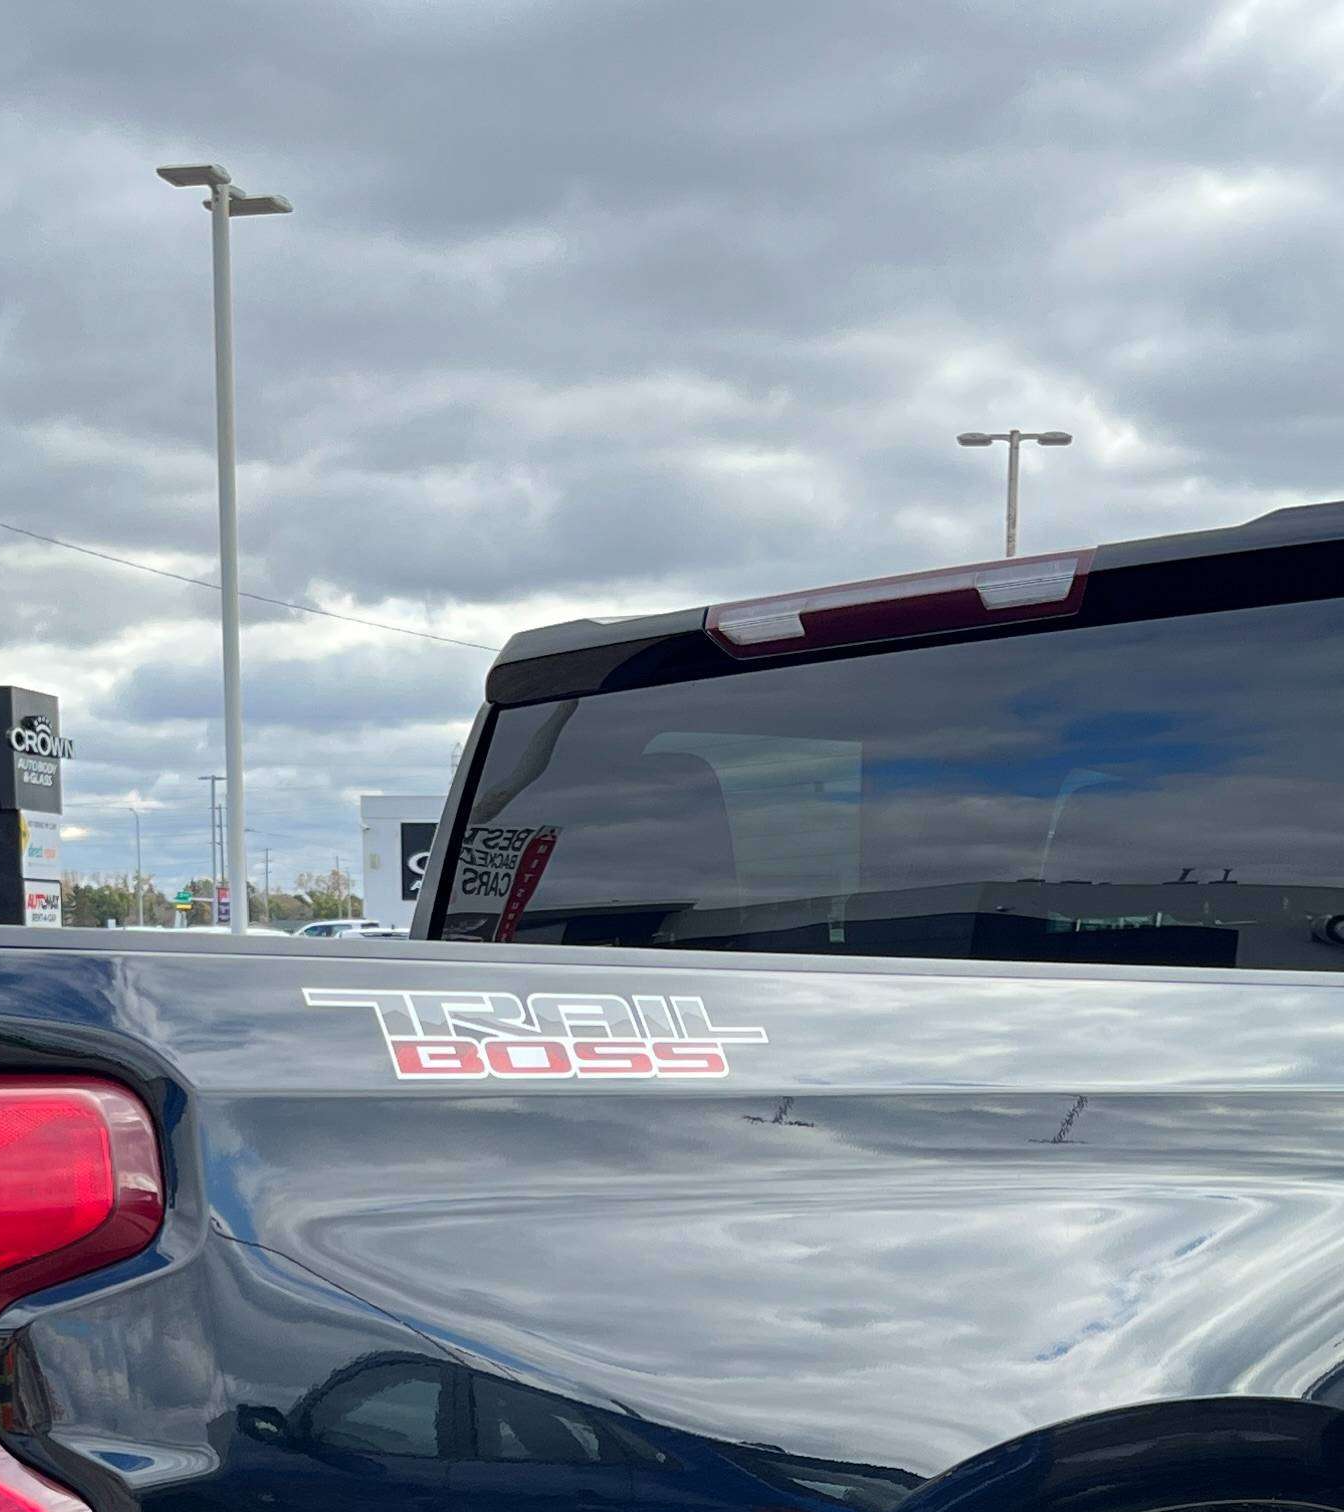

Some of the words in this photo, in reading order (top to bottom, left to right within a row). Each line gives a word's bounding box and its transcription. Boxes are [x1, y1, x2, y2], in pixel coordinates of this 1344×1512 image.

[10, 727, 76, 760] CROWN
[301, 987, 769, 1043] TRAIL
[390, 1039, 730, 1080] BOSS
